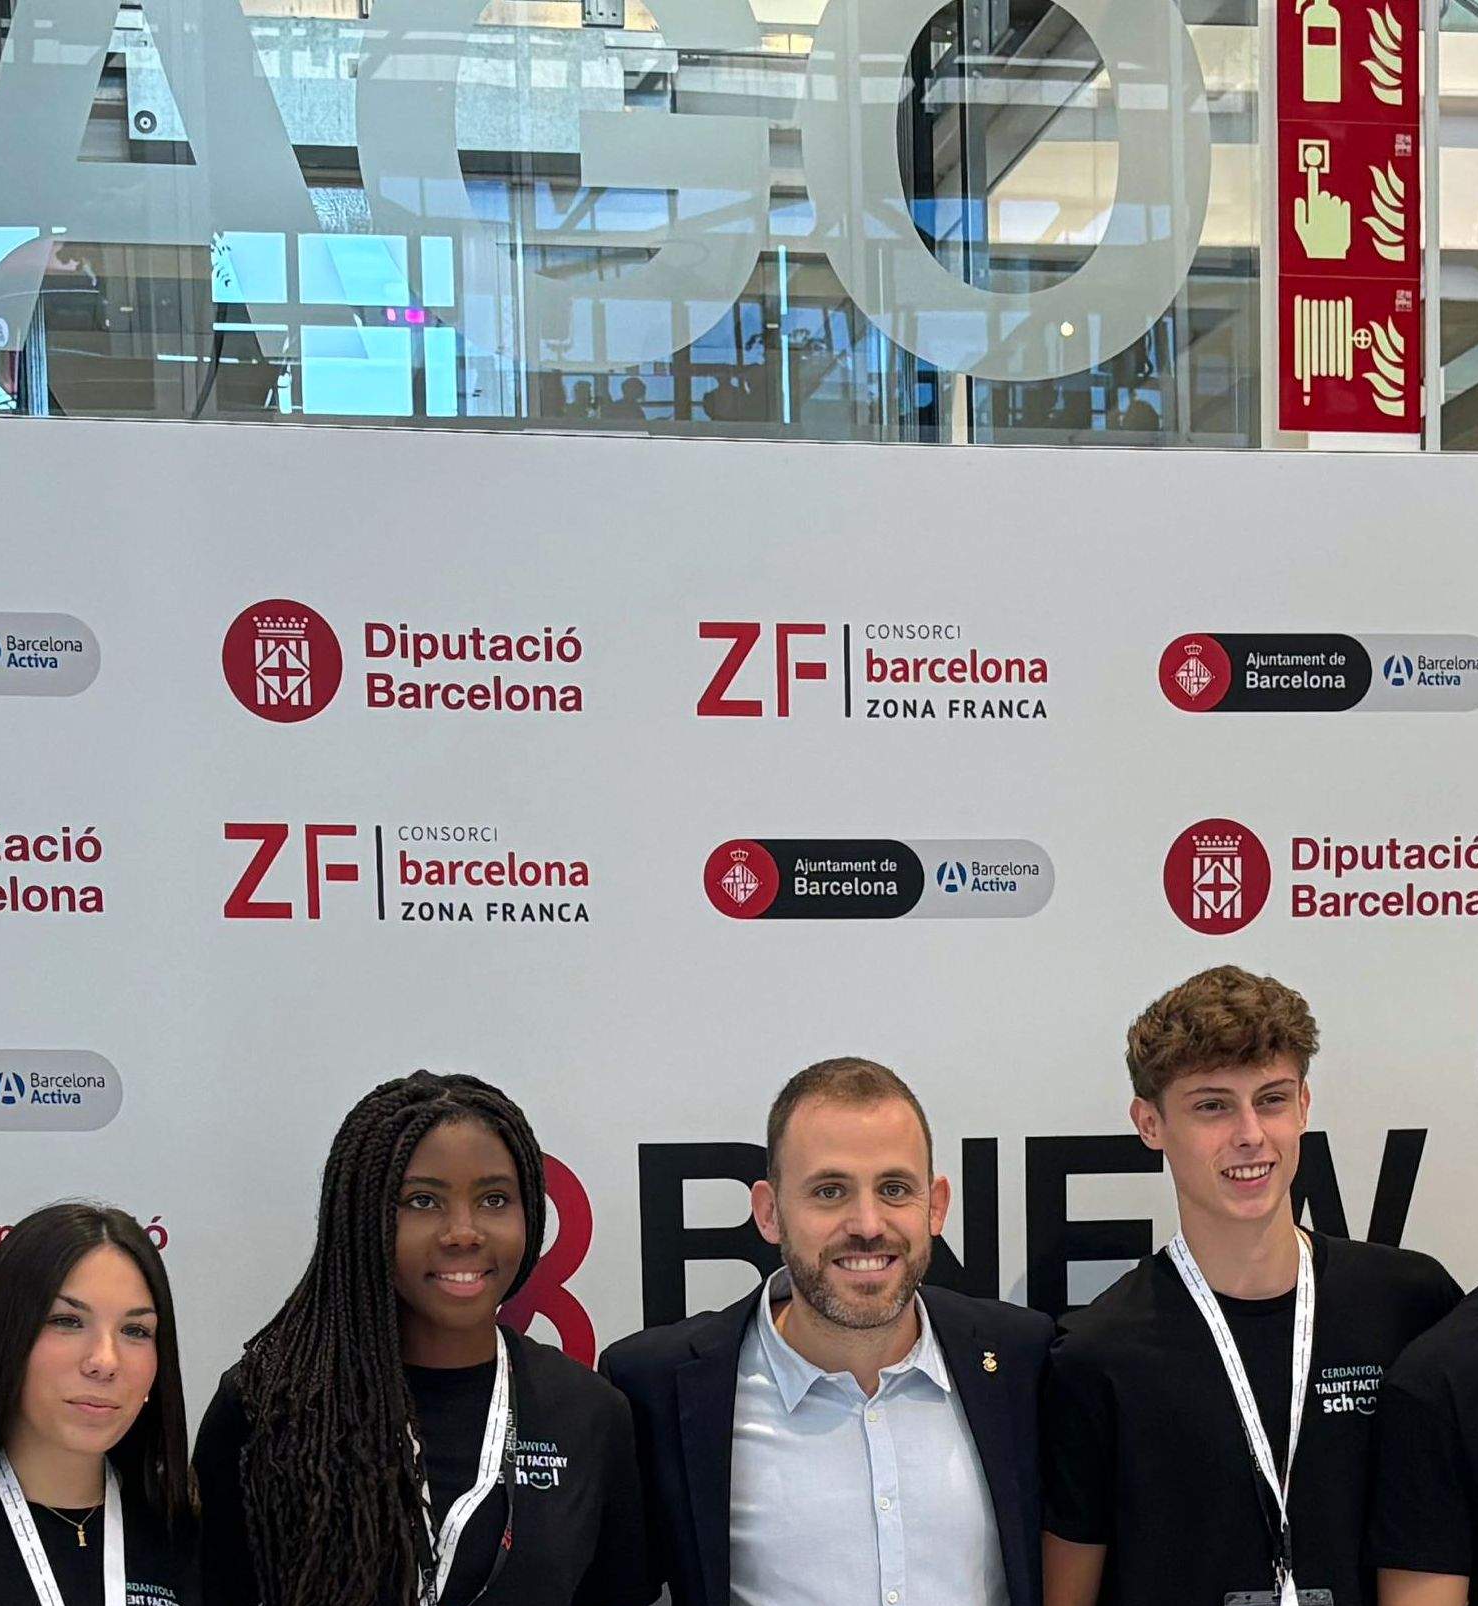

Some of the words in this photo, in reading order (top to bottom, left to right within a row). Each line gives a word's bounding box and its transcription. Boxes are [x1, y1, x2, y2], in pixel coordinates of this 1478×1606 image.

[866, 624, 960, 639] CONSORCI
[7, 635, 82, 652] Barcelona
[365, 623, 581, 667] Diputació
[7, 653, 57, 668] Activa
[866, 648, 1047, 683] barcelona
[1247, 652, 1319, 669] Ajuntament
[1329, 652, 1345, 665] de
[697, 622, 826, 717] ZF
[1417, 671, 1460, 685] Activa
[1246, 671, 1345, 688] Barcelona
[367, 673, 582, 712] Barcelona
[867, 699, 935, 718] ZONA
[949, 700, 1047, 718] FRANCA
[399, 826, 497, 842] CONSORCI
[224, 823, 358, 919] ZF
[400, 850, 588, 886] barcelona
[795, 859, 876, 875] Ajuntament
[880, 859, 897, 871] de
[972, 862, 1039, 876] Barcelona
[795, 877, 897, 895] Barcelona
[971, 877, 1016, 891] Activa
[402, 902, 473, 921] ZONA
[487, 903, 589, 922] FRANCA
[31, 1073, 105, 1088] Barcelona
[31, 1089, 81, 1104] Activa
[1322, 1365, 1383, 1379] CERDANYOLA
[1316, 1380, 1350, 1395] TALENT
[1353, 1378, 1380, 1392] FACT
[1323, 1394, 1377, 1415] schoo
[527, 1455, 568, 1467] FACTORY
[498, 1467, 559, 1490] shool
